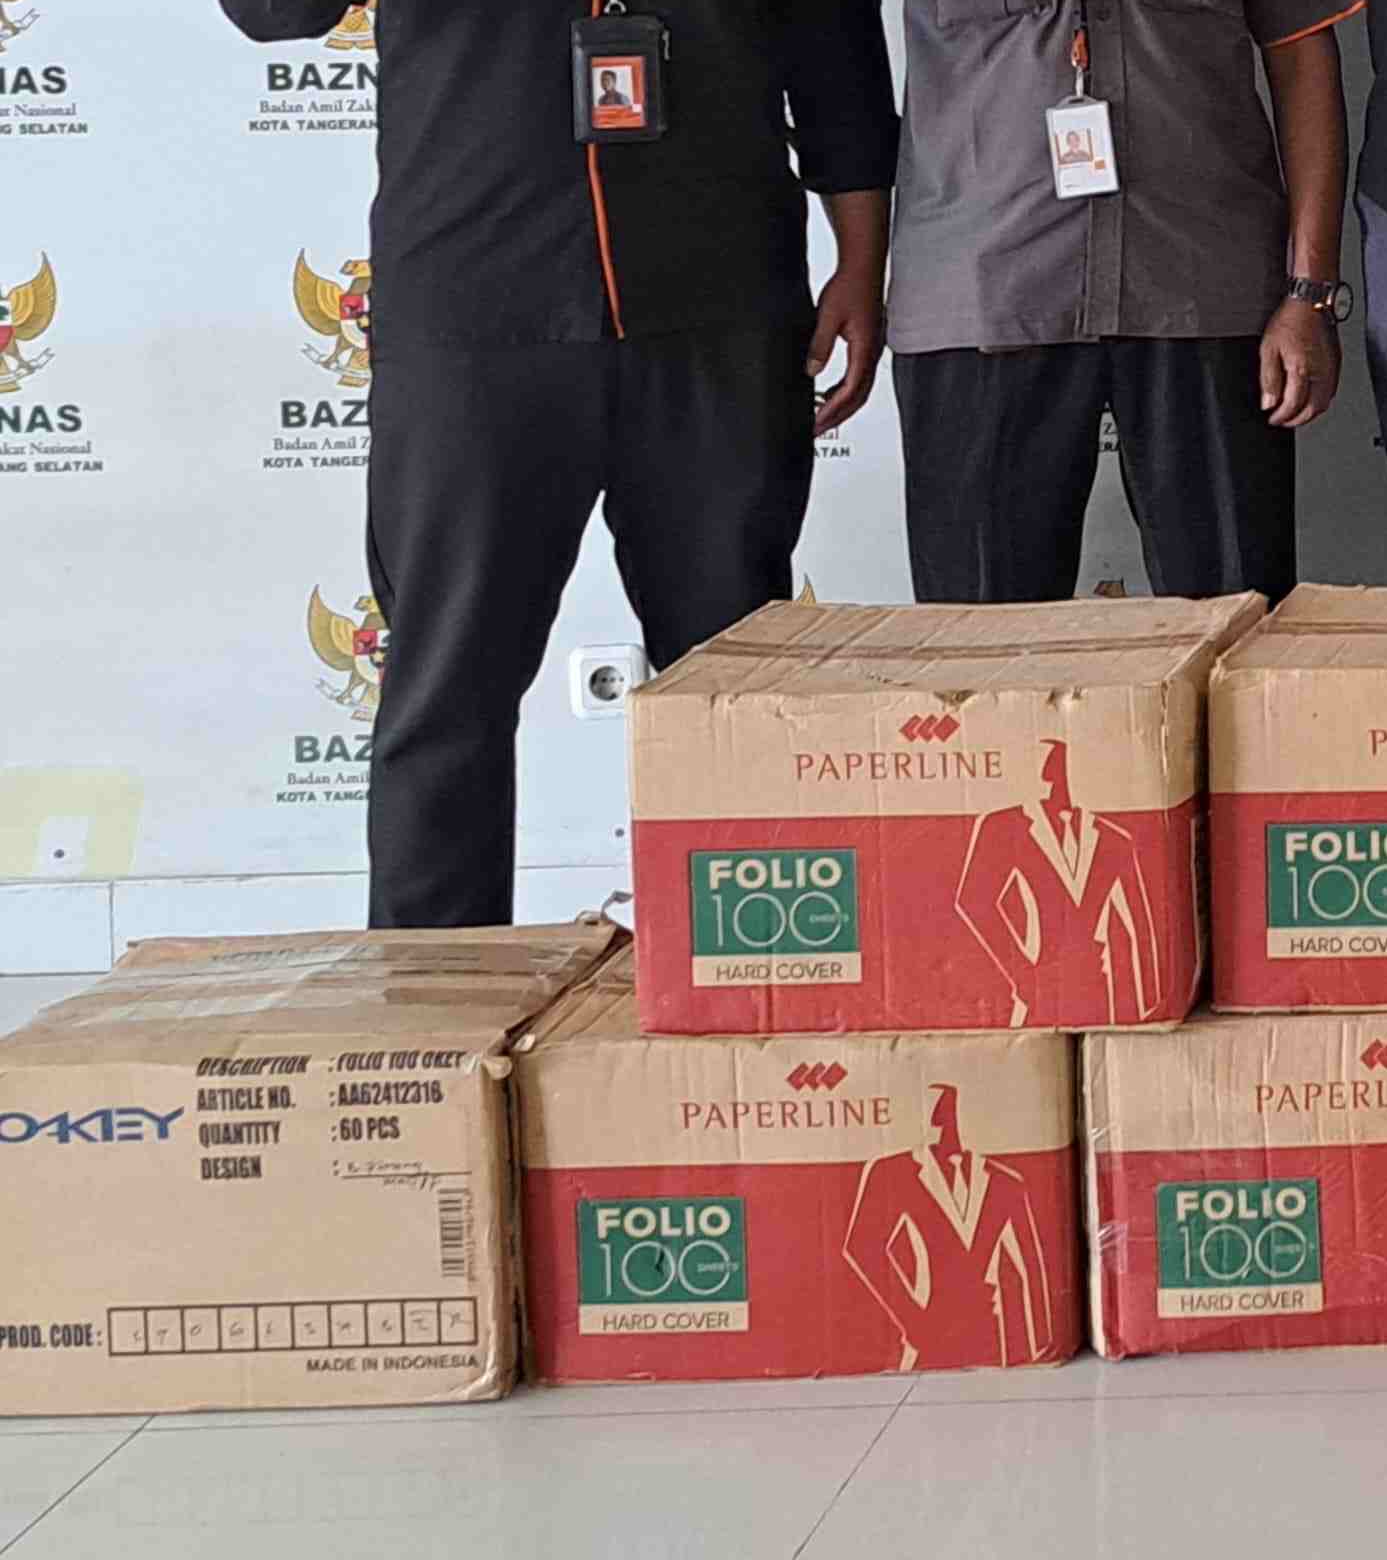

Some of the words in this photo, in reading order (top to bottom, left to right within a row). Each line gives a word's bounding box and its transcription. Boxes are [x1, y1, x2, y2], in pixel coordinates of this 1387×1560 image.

[793, 750, 1004, 782] PAPERLINE
[709, 857, 842, 890] FOLIO
[711, 890, 841, 948] 100
[1290, 936, 1345, 954] HARD
[716, 963, 771, 981] HARD
[775, 961, 843, 980] COVER
[196, 1054, 312, 1077] DESCRIPTION
[197, 1087, 264, 1112] ARTICLE
[267, 1086, 296, 1109] NO.
[681, 1098, 892, 1129] PAPERLINE
[199, 1121, 281, 1148] QUANTITY
[367, 1116, 400, 1140] PCS
[201, 1156, 262, 1181] DESIGN
[1176, 1190, 1306, 1221] FOLIO
[596, 1206, 731, 1239] FOLIO
[1180, 1222, 1306, 1281] 100
[599, 1241, 731, 1297] 100
[1180, 1293, 1234, 1311] HARD
[1239, 1291, 1304, 1310] COVER
[602, 1313, 657, 1331] HARD
[662, 1311, 729, 1330] COVER
[0, 1324, 47, 1349] PROD.
[307, 1357, 358, 1372] MADE
[362, 1357, 378, 1371] IN
[384, 1355, 478, 1371] INDONESIA
